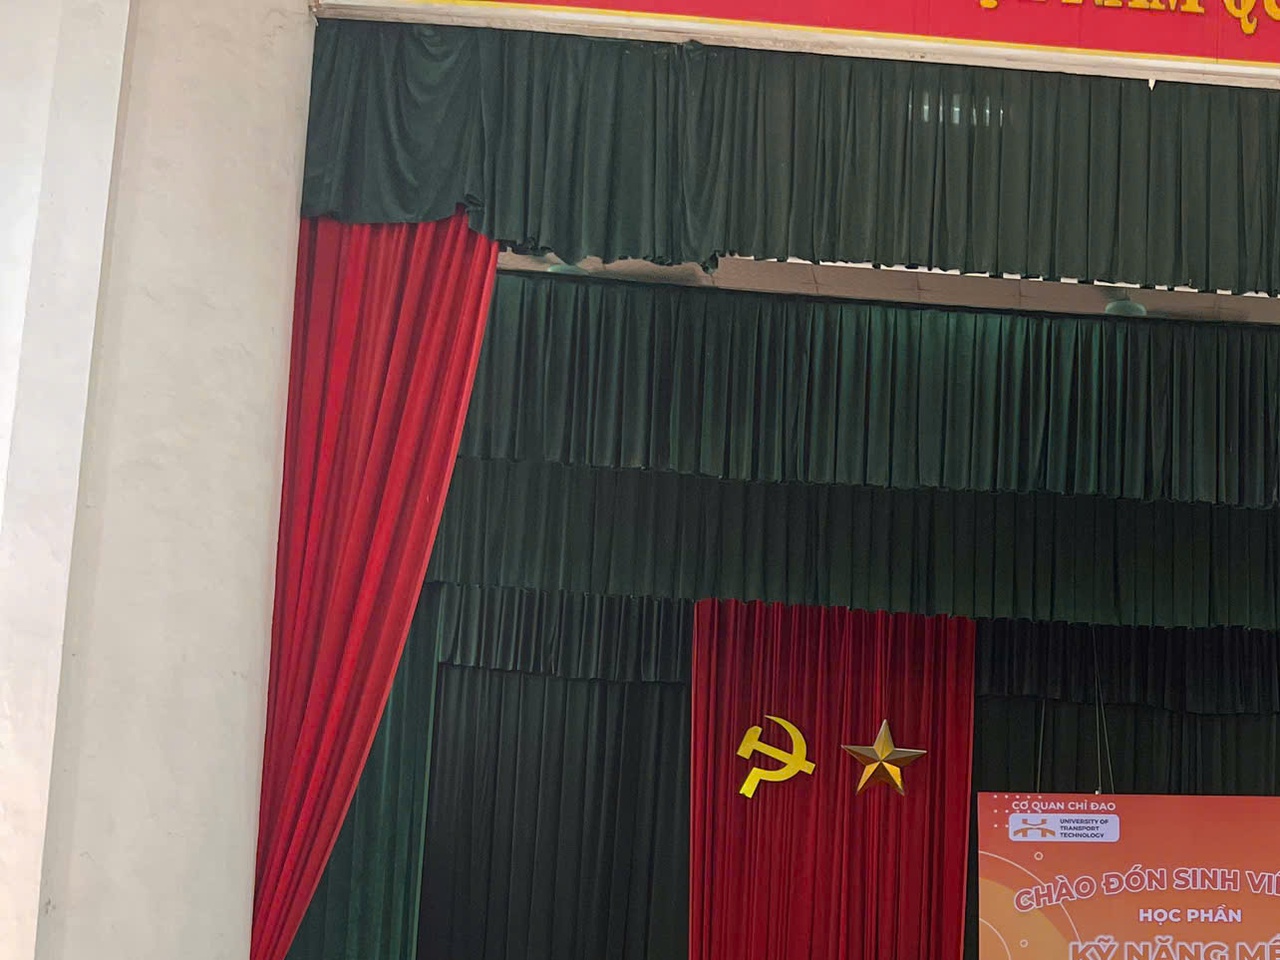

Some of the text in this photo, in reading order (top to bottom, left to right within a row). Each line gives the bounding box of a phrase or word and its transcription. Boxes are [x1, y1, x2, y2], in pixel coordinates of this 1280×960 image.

[1012, 800, 1029, 810] CƠ
[1031, 801, 1065, 813] QUAN
[1090, 801, 1116, 813] ĐẠO
[1014, 875, 1096, 912] CHÀO
[1102, 864, 1167, 895] ĐÓN
[1173, 867, 1240, 892] SINH
[1139, 904, 1242, 926] HỌC PHẦN
